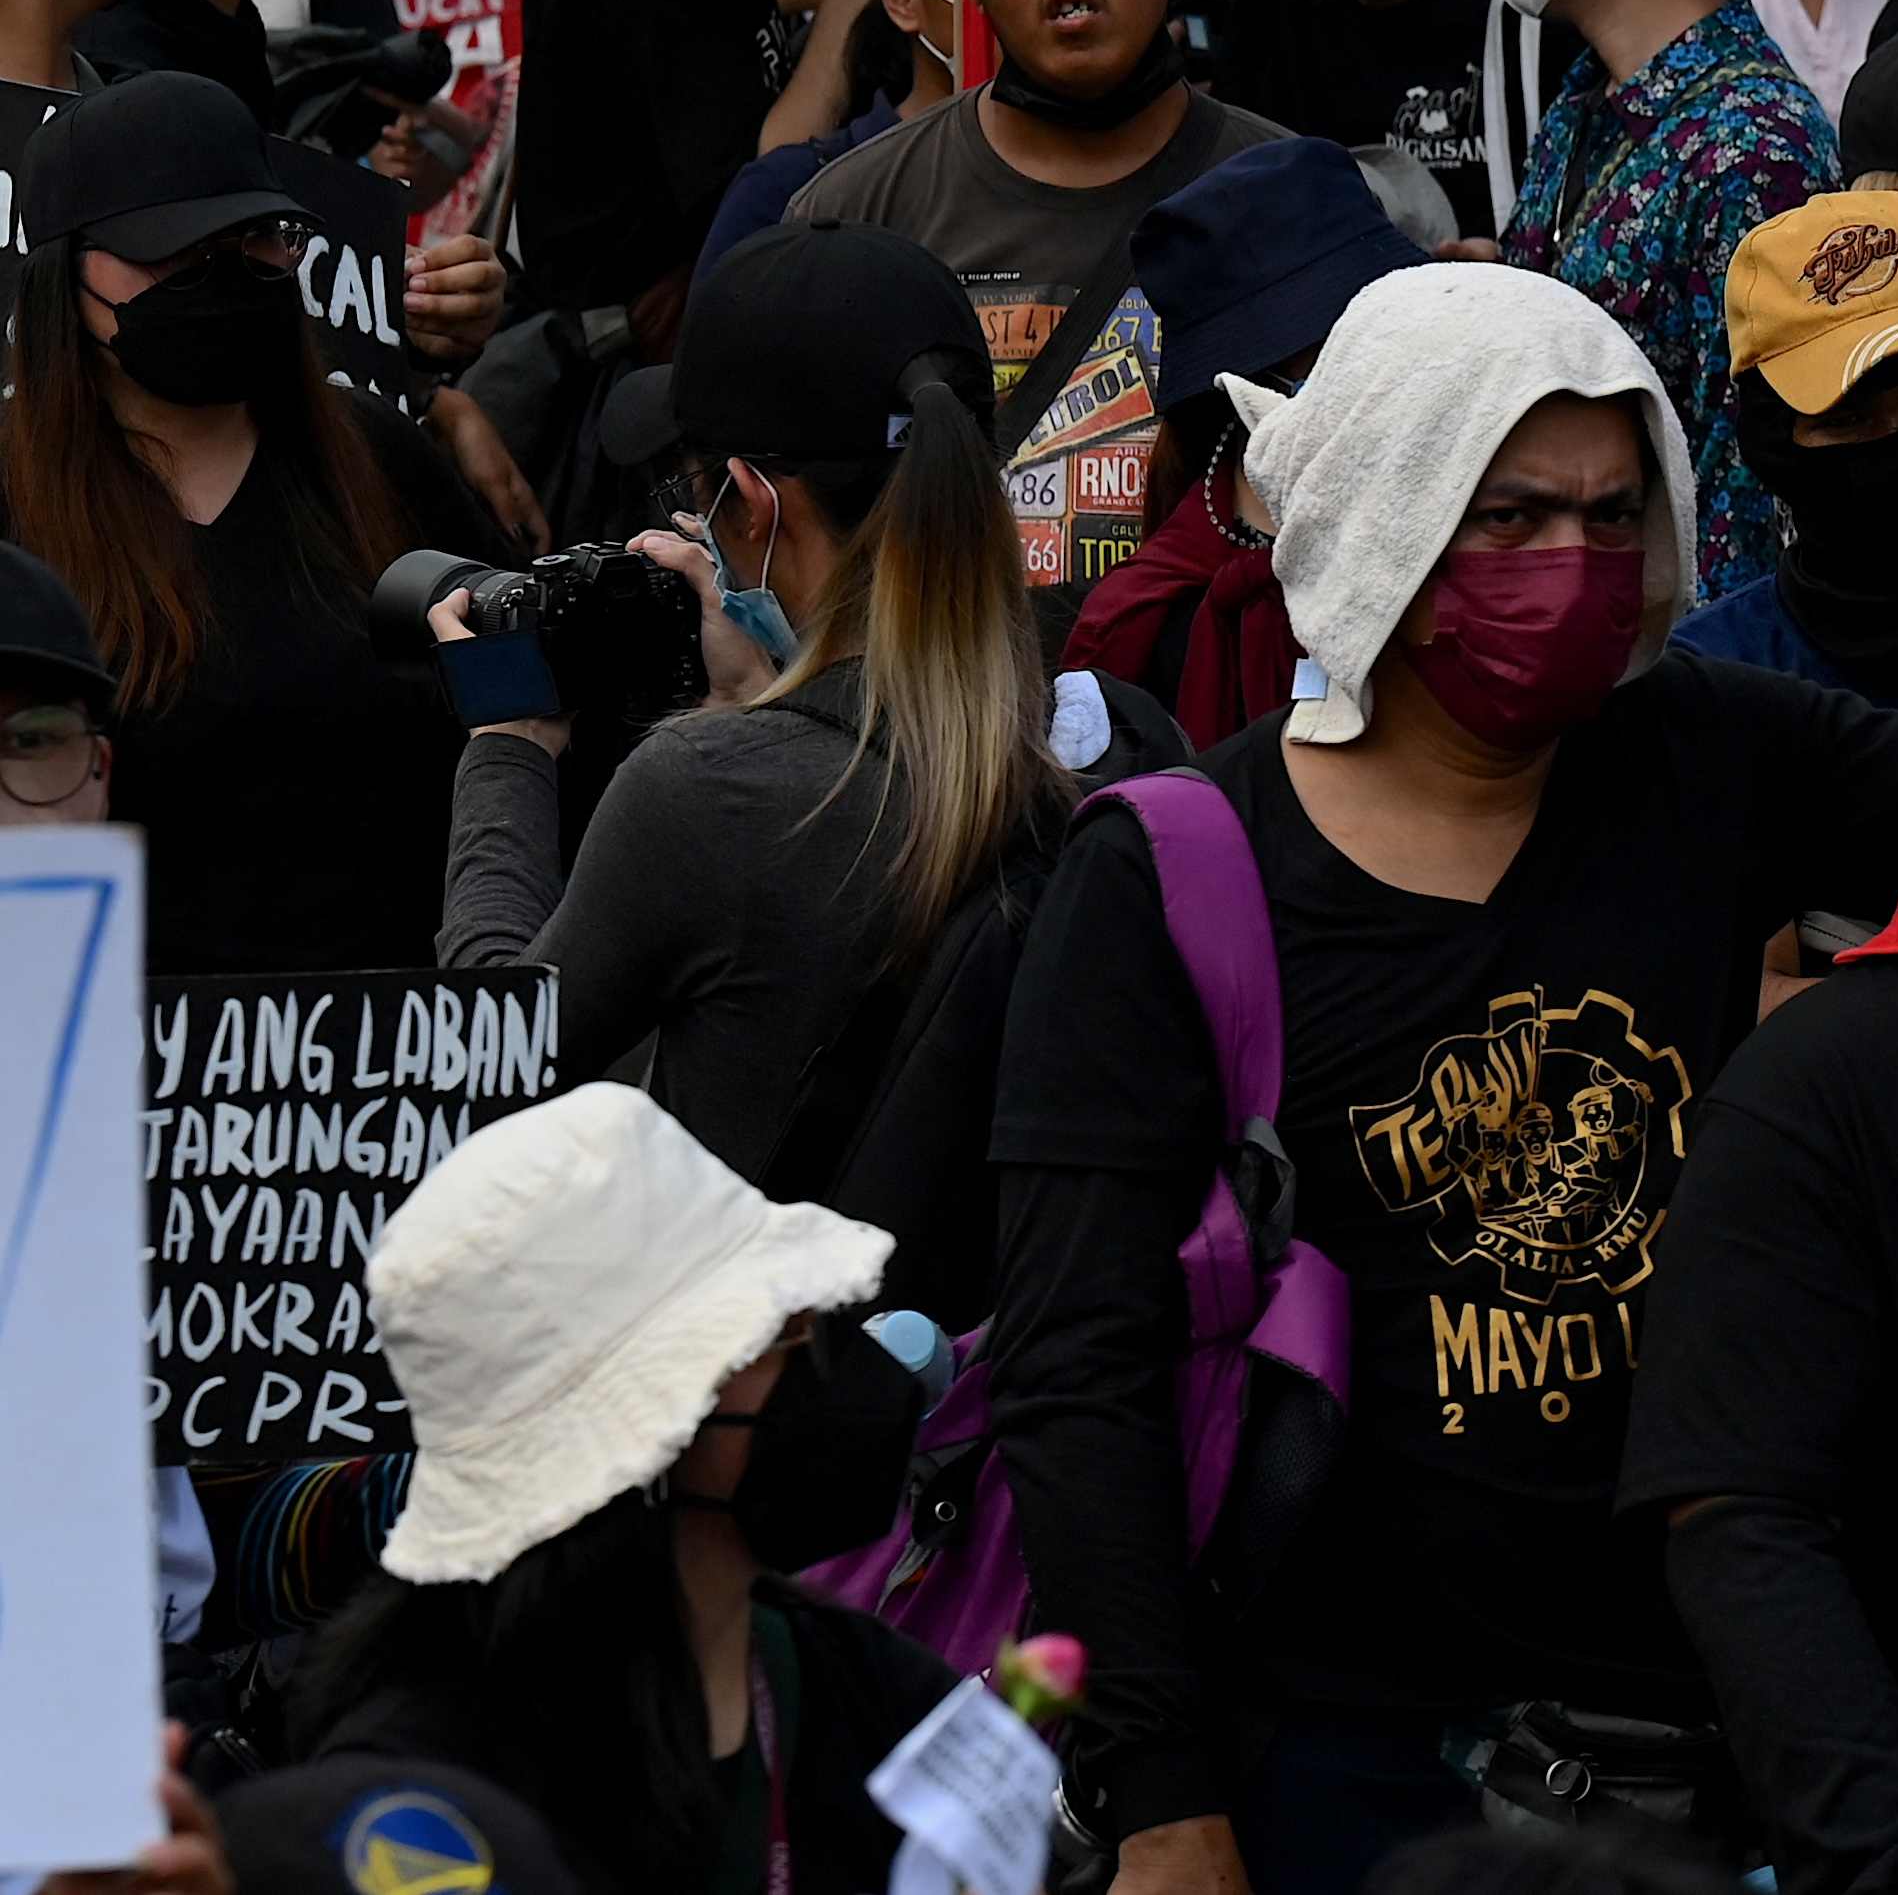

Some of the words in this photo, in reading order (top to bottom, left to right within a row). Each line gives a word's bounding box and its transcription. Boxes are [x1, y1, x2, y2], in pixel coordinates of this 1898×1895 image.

[200, 988, 334, 1099] ANG
[351, 973, 560, 1103] LABAN!
[1475, 1229, 1575, 1276] OLALIA
[1593, 1206, 1650, 1263] KMU
[1429, 1294, 1602, 1398] MAYO
